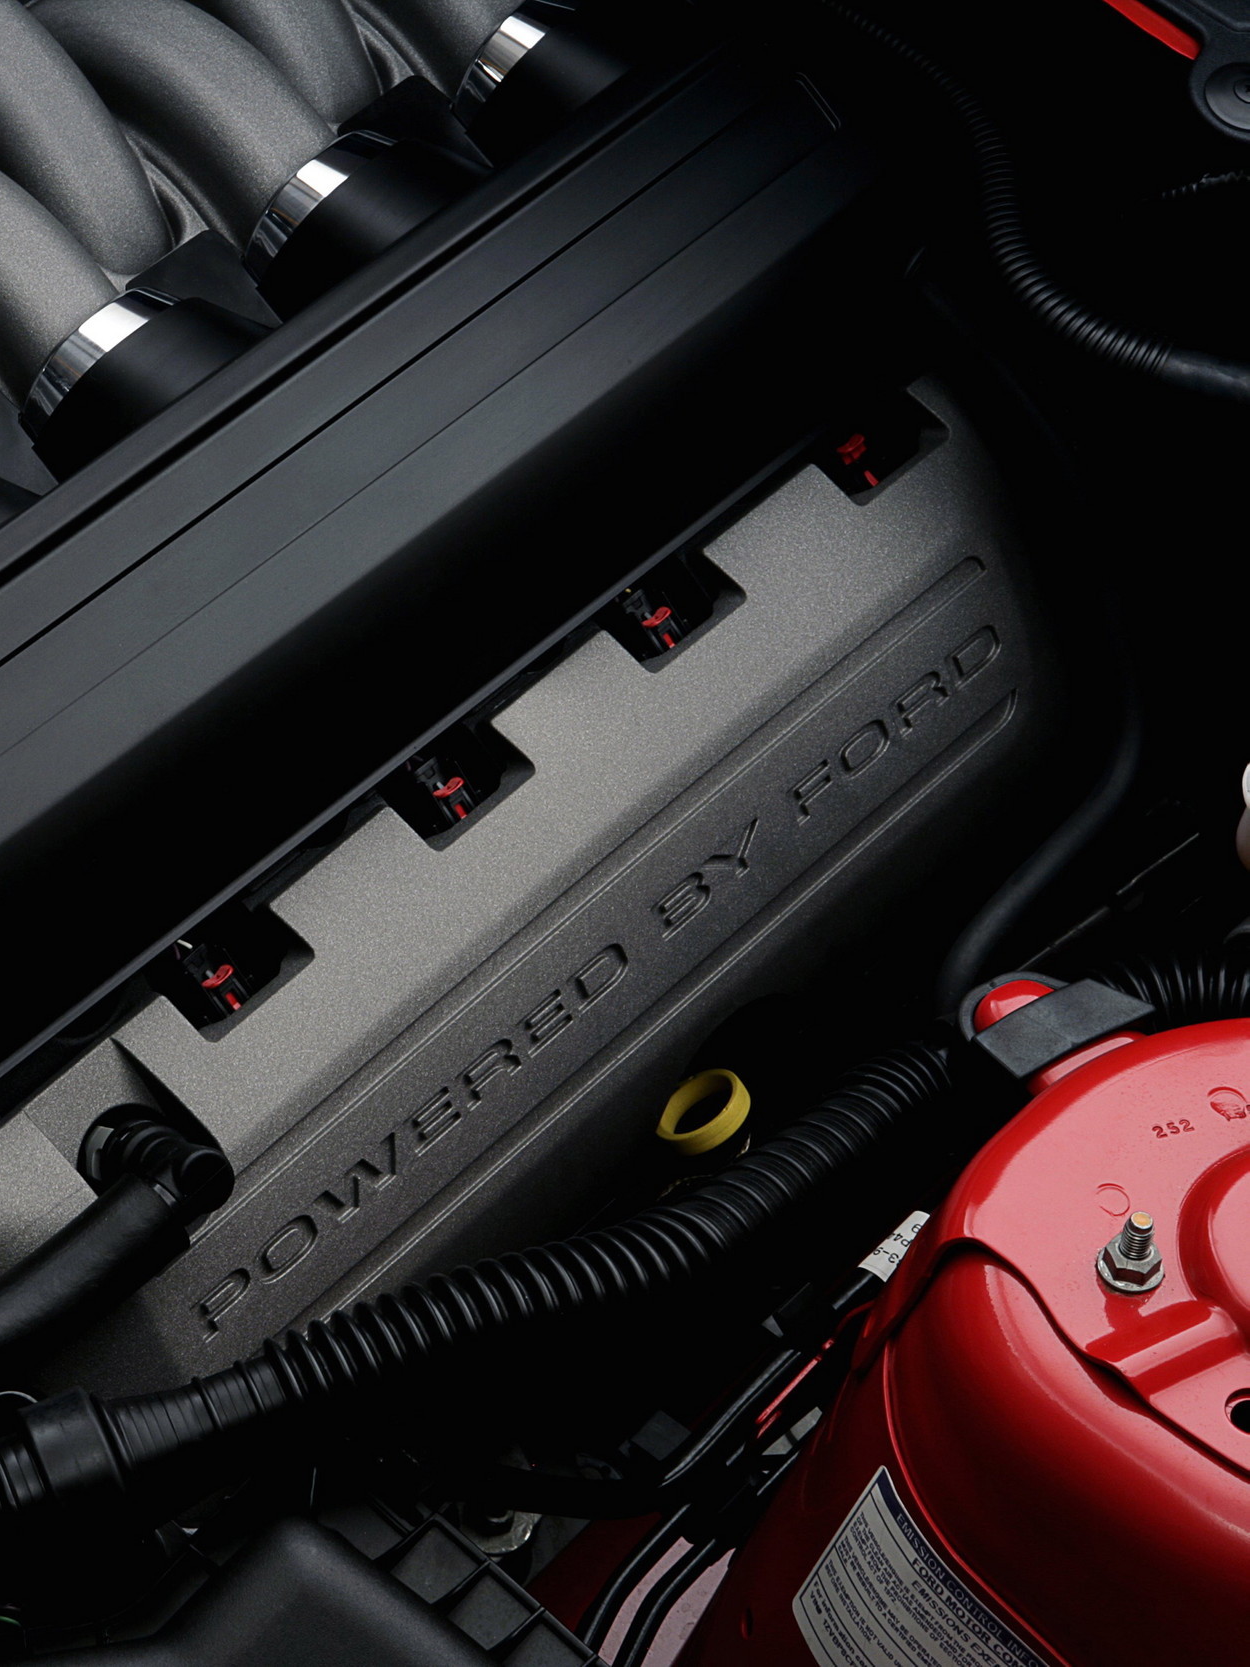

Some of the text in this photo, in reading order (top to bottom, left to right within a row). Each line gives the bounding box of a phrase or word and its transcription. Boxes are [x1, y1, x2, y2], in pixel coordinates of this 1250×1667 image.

[190, 623, 1003, 1343] POWERED BY FORD
[1152, 1119, 1195, 1139] 252
[896, 1513, 946, 1580] EMISSION
[946, 1580, 1002, 1639] CONTROL
[911, 1580, 971, 1642] EMISSIONS
[912, 1557, 944, 1595] FORD
[945, 1595, 991, 1643] MOTOR
